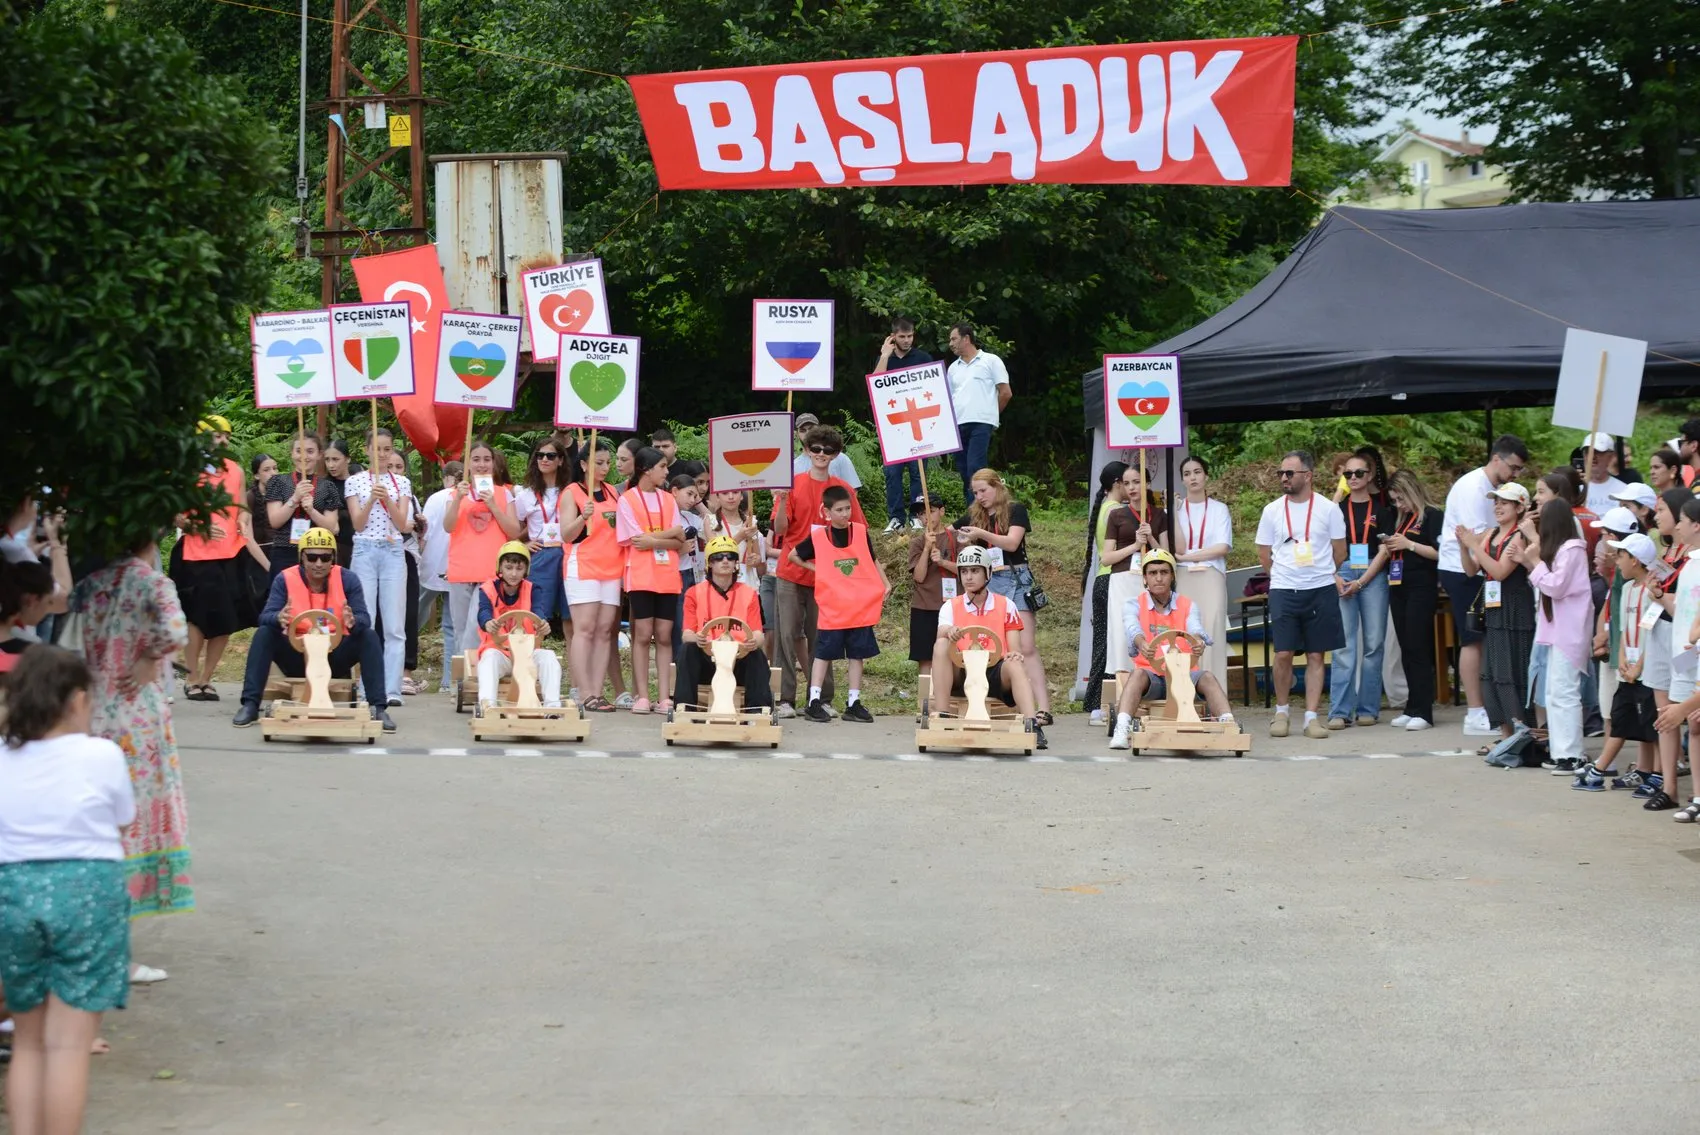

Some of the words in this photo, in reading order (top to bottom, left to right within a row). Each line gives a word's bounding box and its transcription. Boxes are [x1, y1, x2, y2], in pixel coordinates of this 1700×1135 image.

[674, 50, 1249, 184] BAŞLADUK
[530, 265, 595, 288] TÜRKİYE
[334, 307, 406, 324] ÇEÇENİSTAN
[768, 305, 819, 318] RUSYA
[443, 319, 480, 329] KARAÇAY
[488, 323, 518, 332] ÇERKES
[467, 329, 493, 337] ORAYDA
[569, 339, 629, 354] ADYGEA
[586, 353, 611, 361] DJIGIT
[1111, 362, 1173, 372] AZERBAYCAN
[874, 367, 940, 389] GÜRCİSTAN
[731, 420, 771, 430] OSETYA
